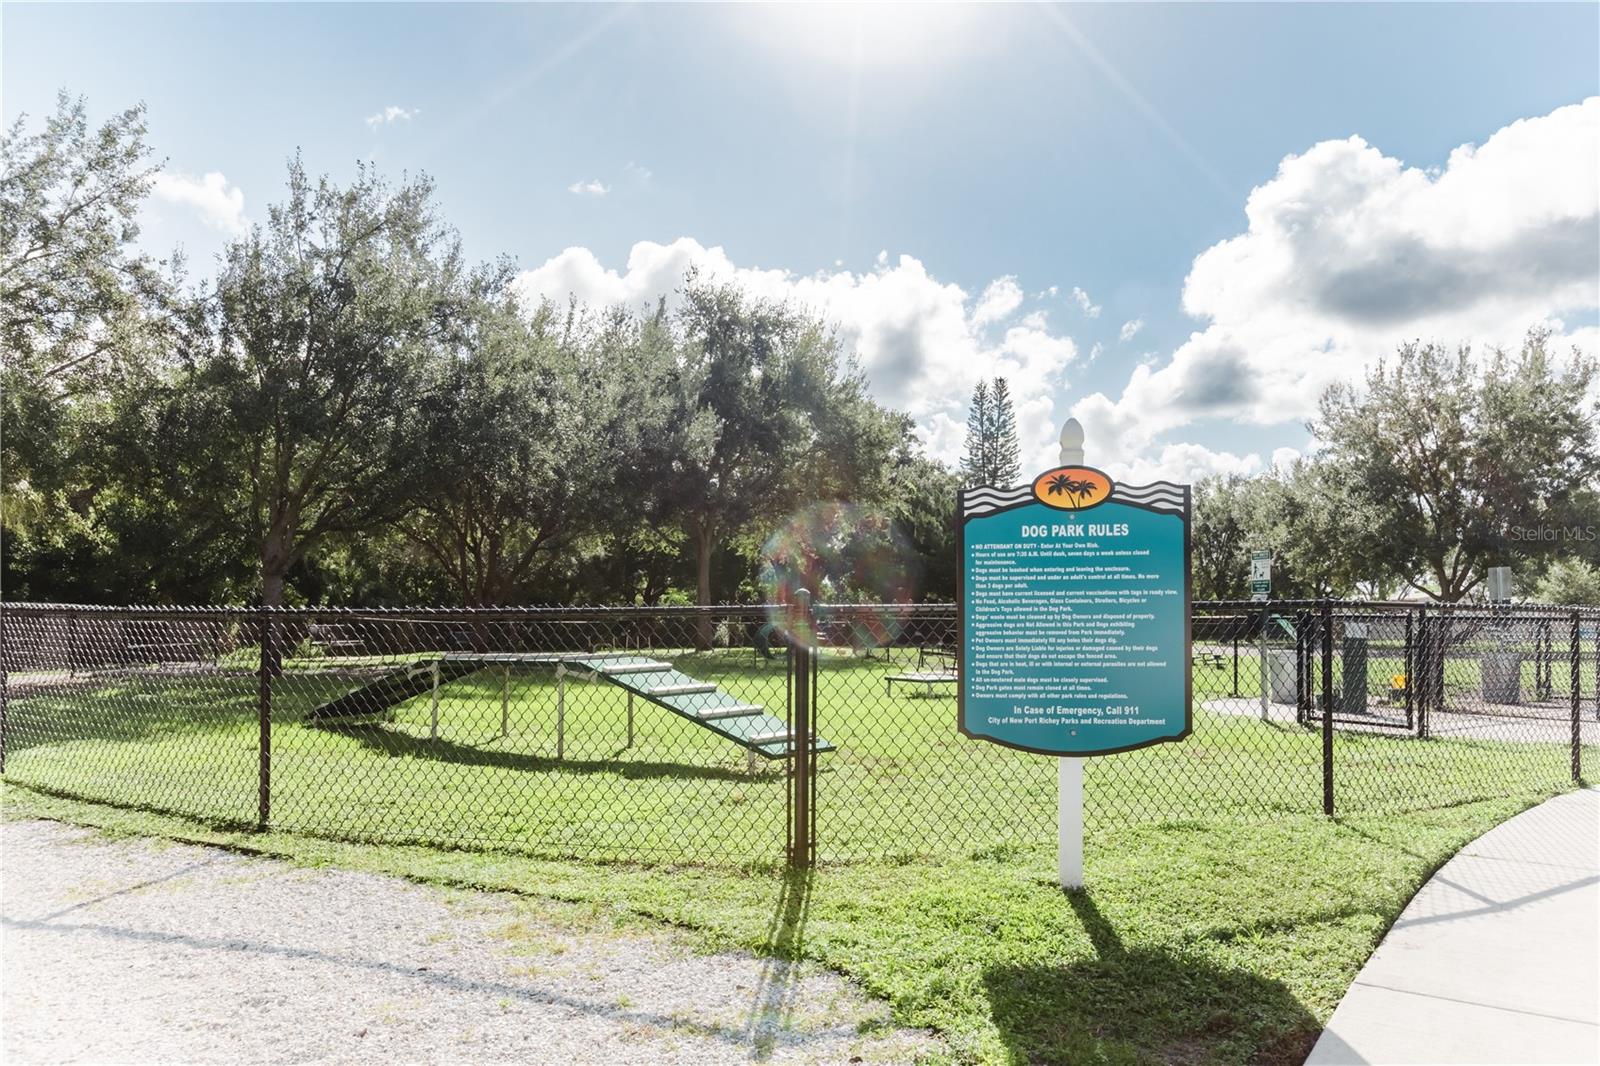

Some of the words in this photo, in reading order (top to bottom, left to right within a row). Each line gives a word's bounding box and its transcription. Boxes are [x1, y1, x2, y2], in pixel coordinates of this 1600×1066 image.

[1021, 525, 1048, 537] DOG
[1051, 524, 1084, 537] PARK
[1088, 524, 1129, 536] RULES
[1013, 706, 1022, 714] In
[1024, 706, 1044, 714] Case
[1046, 706, 1055, 714] of
[1056, 706, 1104, 716] Emergency,
[1106, 706, 1122, 715] Call
[1124, 706, 1139, 715] 911
[987, 716, 1001, 725] City
[1039, 717, 1060, 725] Richey
